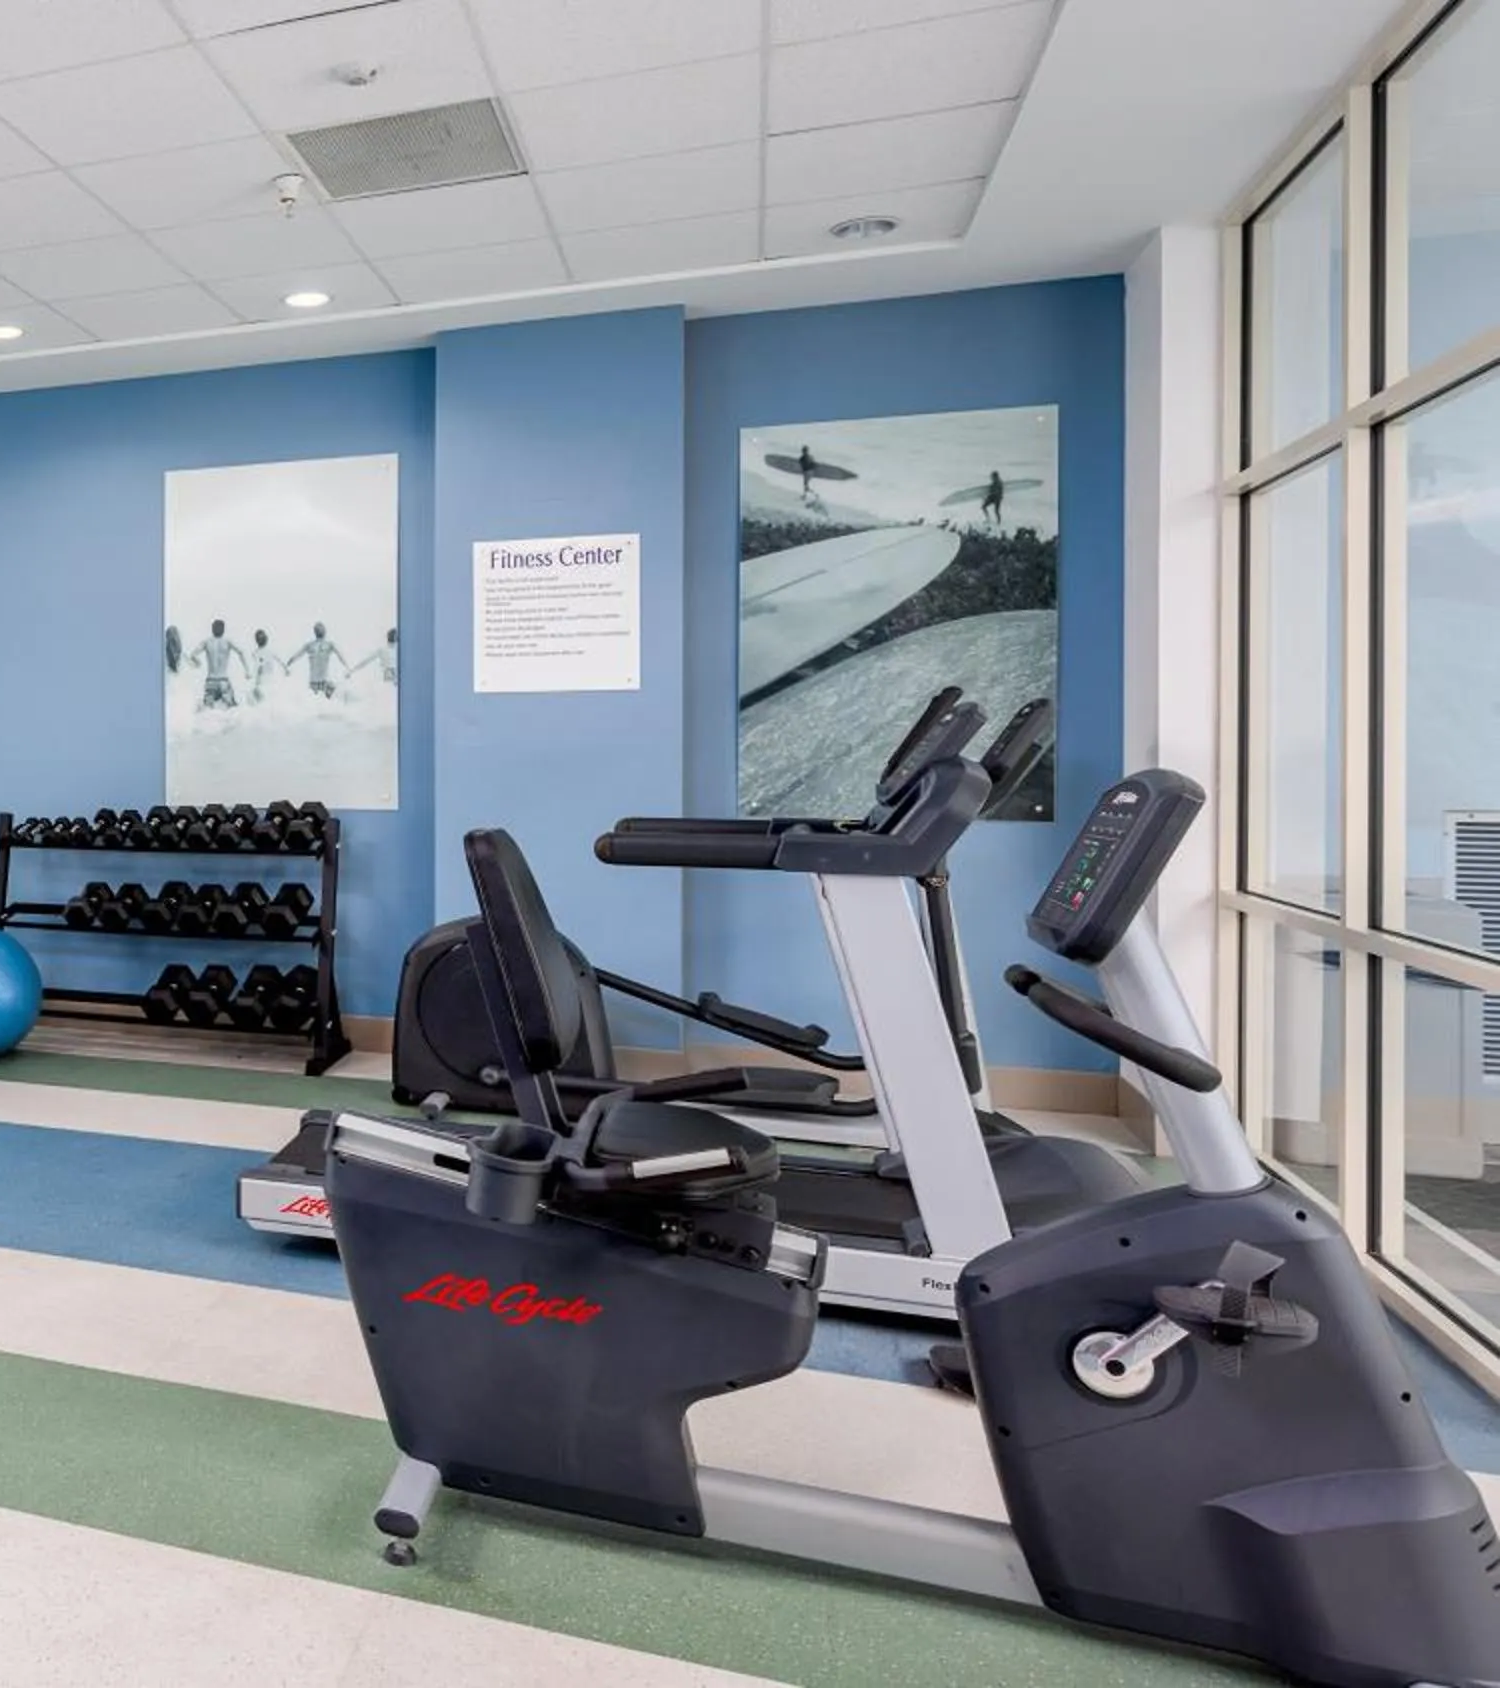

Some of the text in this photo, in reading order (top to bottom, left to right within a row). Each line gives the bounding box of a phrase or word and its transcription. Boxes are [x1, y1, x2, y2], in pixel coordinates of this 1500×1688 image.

[490, 545, 624, 570] Fitness Center
[921, 1277, 958, 1291] Flex
[401, 1272, 604, 1326] Life Cycle
